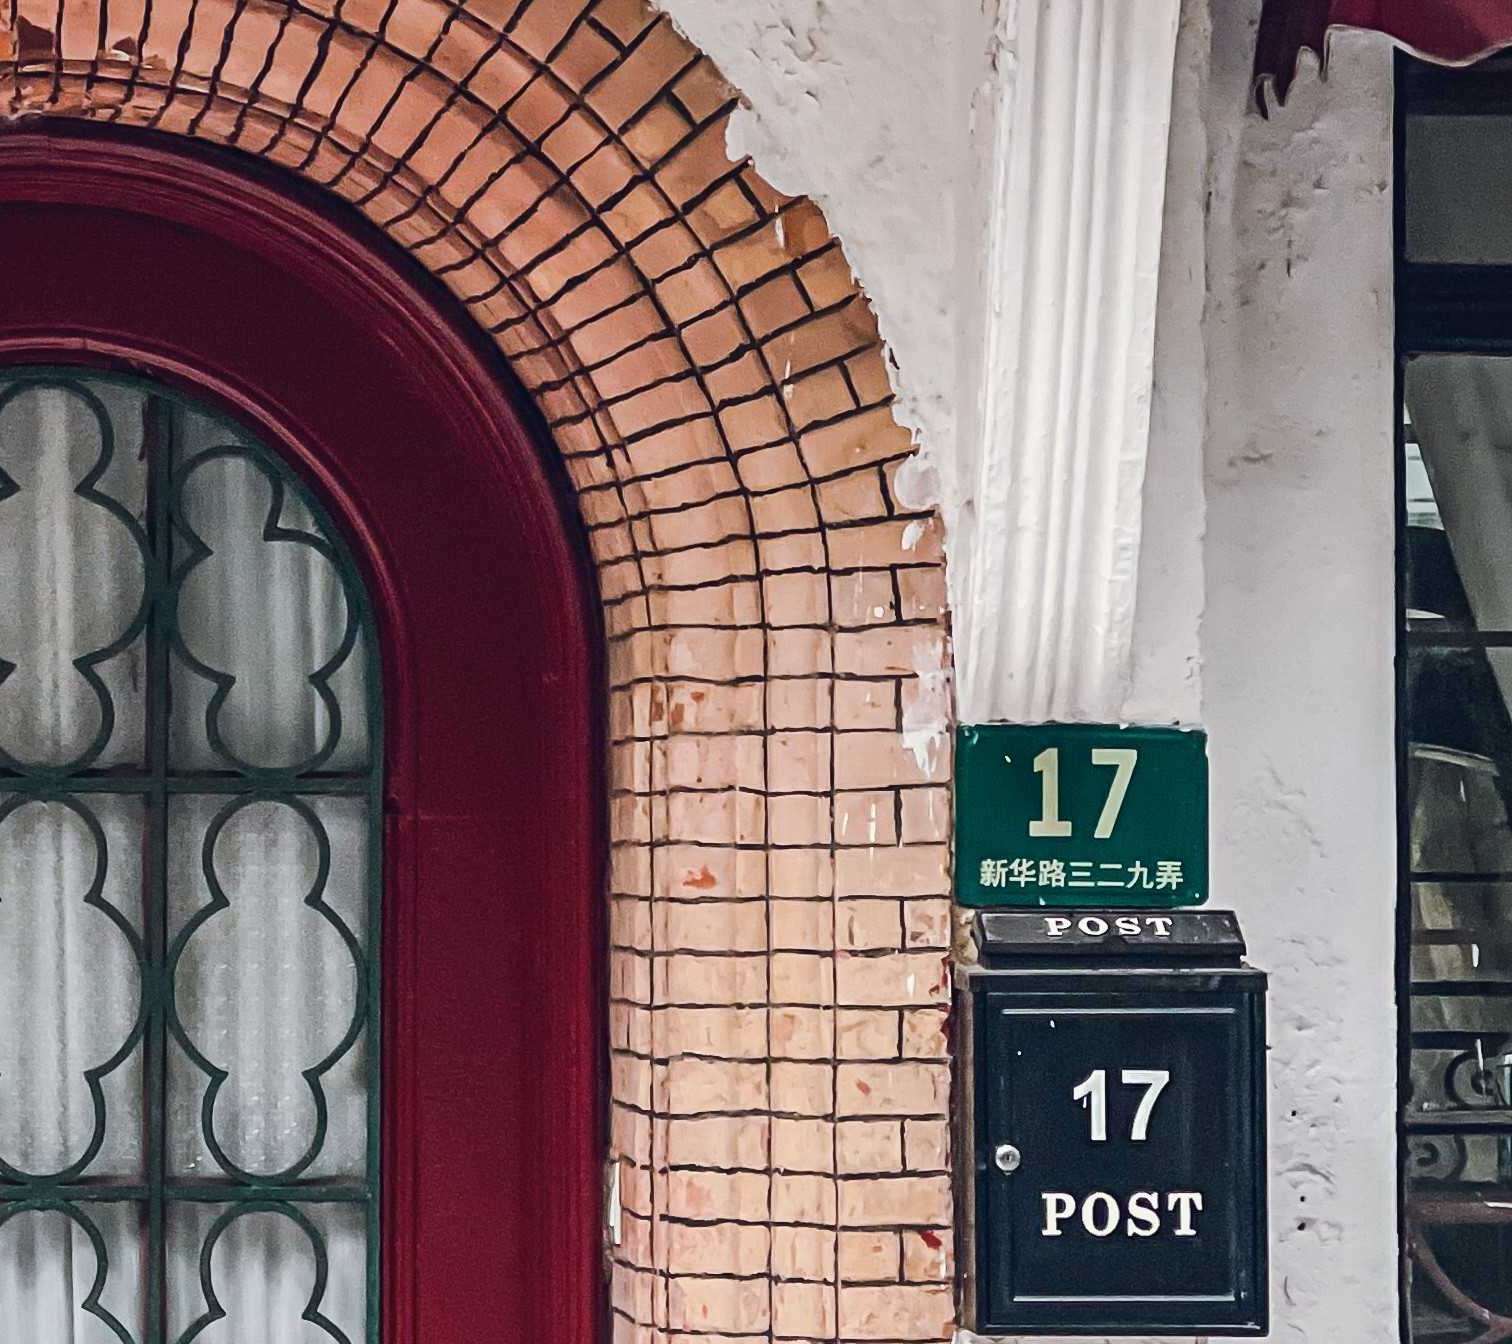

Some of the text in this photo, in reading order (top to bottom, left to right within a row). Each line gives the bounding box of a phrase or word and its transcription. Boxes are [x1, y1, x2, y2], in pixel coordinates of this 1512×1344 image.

[1029, 747, 1138, 839] 17
[979, 858, 1184, 891] 新华路三二九弄
[1044, 917, 1174, 937] POST
[1073, 1069, 1170, 1141] 17
[1041, 1191, 1203, 1237] POST
